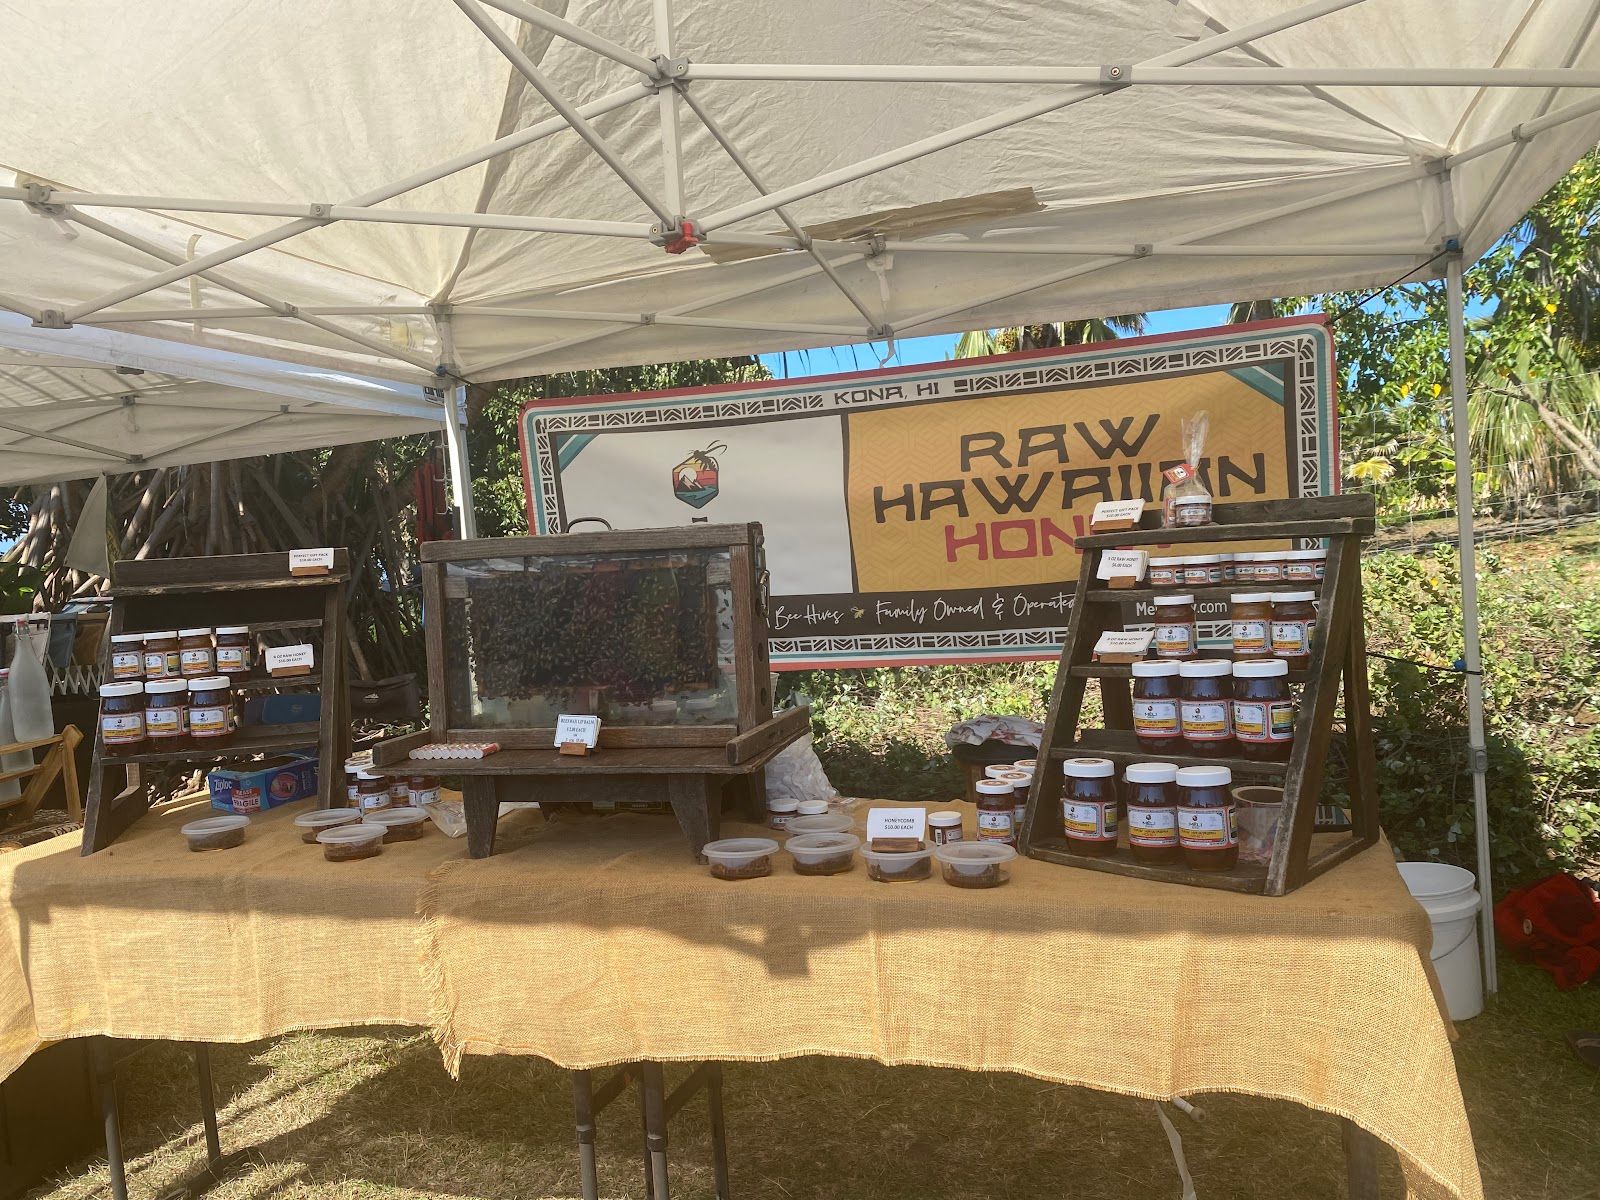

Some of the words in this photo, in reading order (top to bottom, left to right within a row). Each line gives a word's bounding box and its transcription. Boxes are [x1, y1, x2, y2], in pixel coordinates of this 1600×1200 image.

[834, 386, 908, 404] KONA,
[916, 382, 940, 396] HI
[960, 414, 1160, 473] RAW
[944, 514, 1171, 563] HON
[775, 606, 802, 630] Bee
[803, 604, 844, 624] Hives
[876, 599, 928, 624] Family
[934, 597, 984, 620] Owned
[992, 593, 1005, 620] &
[214, 779, 232, 792] Ziploc
